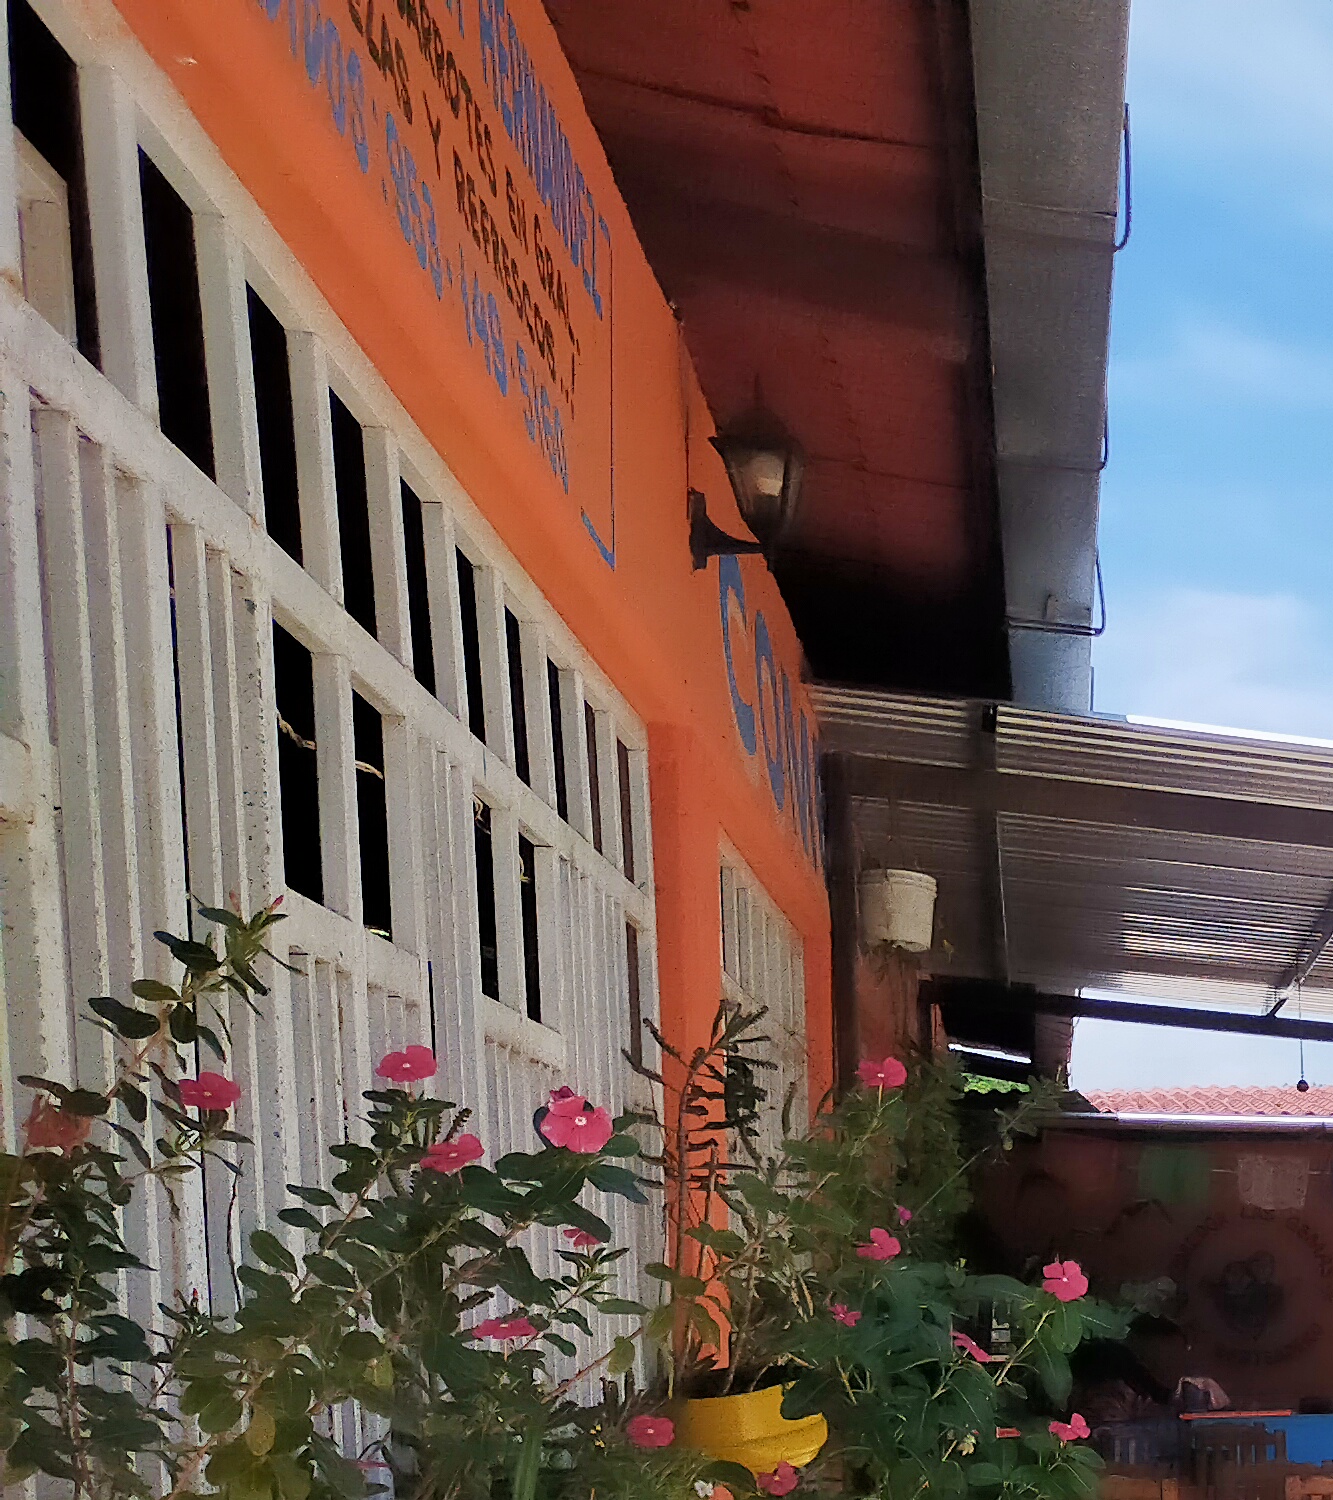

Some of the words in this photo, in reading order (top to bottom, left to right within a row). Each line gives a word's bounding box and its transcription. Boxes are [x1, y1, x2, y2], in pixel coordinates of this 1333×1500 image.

[399, 0, 498, 198] ARROTES
[505, 164, 528, 255] EN
[422, 90, 442, 181] Y
[452, 145, 557, 384] REFRESCOS
